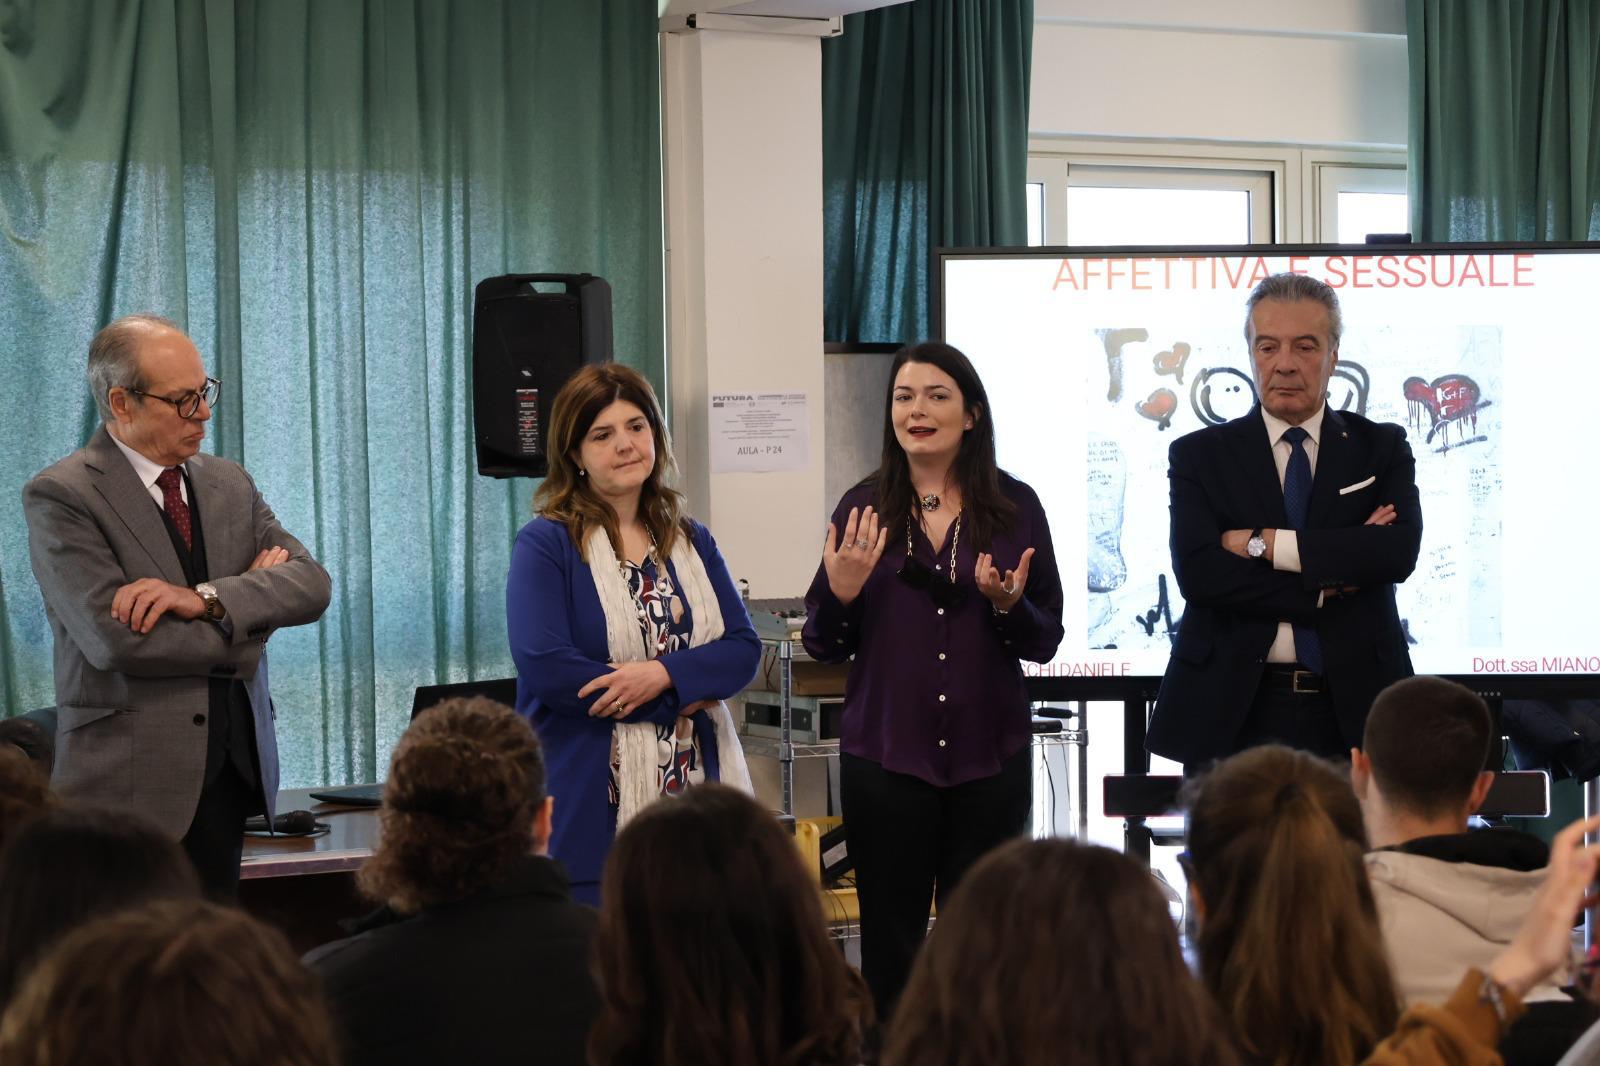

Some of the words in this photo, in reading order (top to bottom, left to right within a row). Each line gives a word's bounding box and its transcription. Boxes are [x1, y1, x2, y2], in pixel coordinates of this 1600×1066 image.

[1052, 256, 1270, 290] AFFETTIVA
[1324, 253, 1535, 288] SESSUALE
[737, 446, 759, 455] AULA
[1473, 657, 1538, 673] Dott.ssa
[1542, 656, 1600, 672] MIANO
